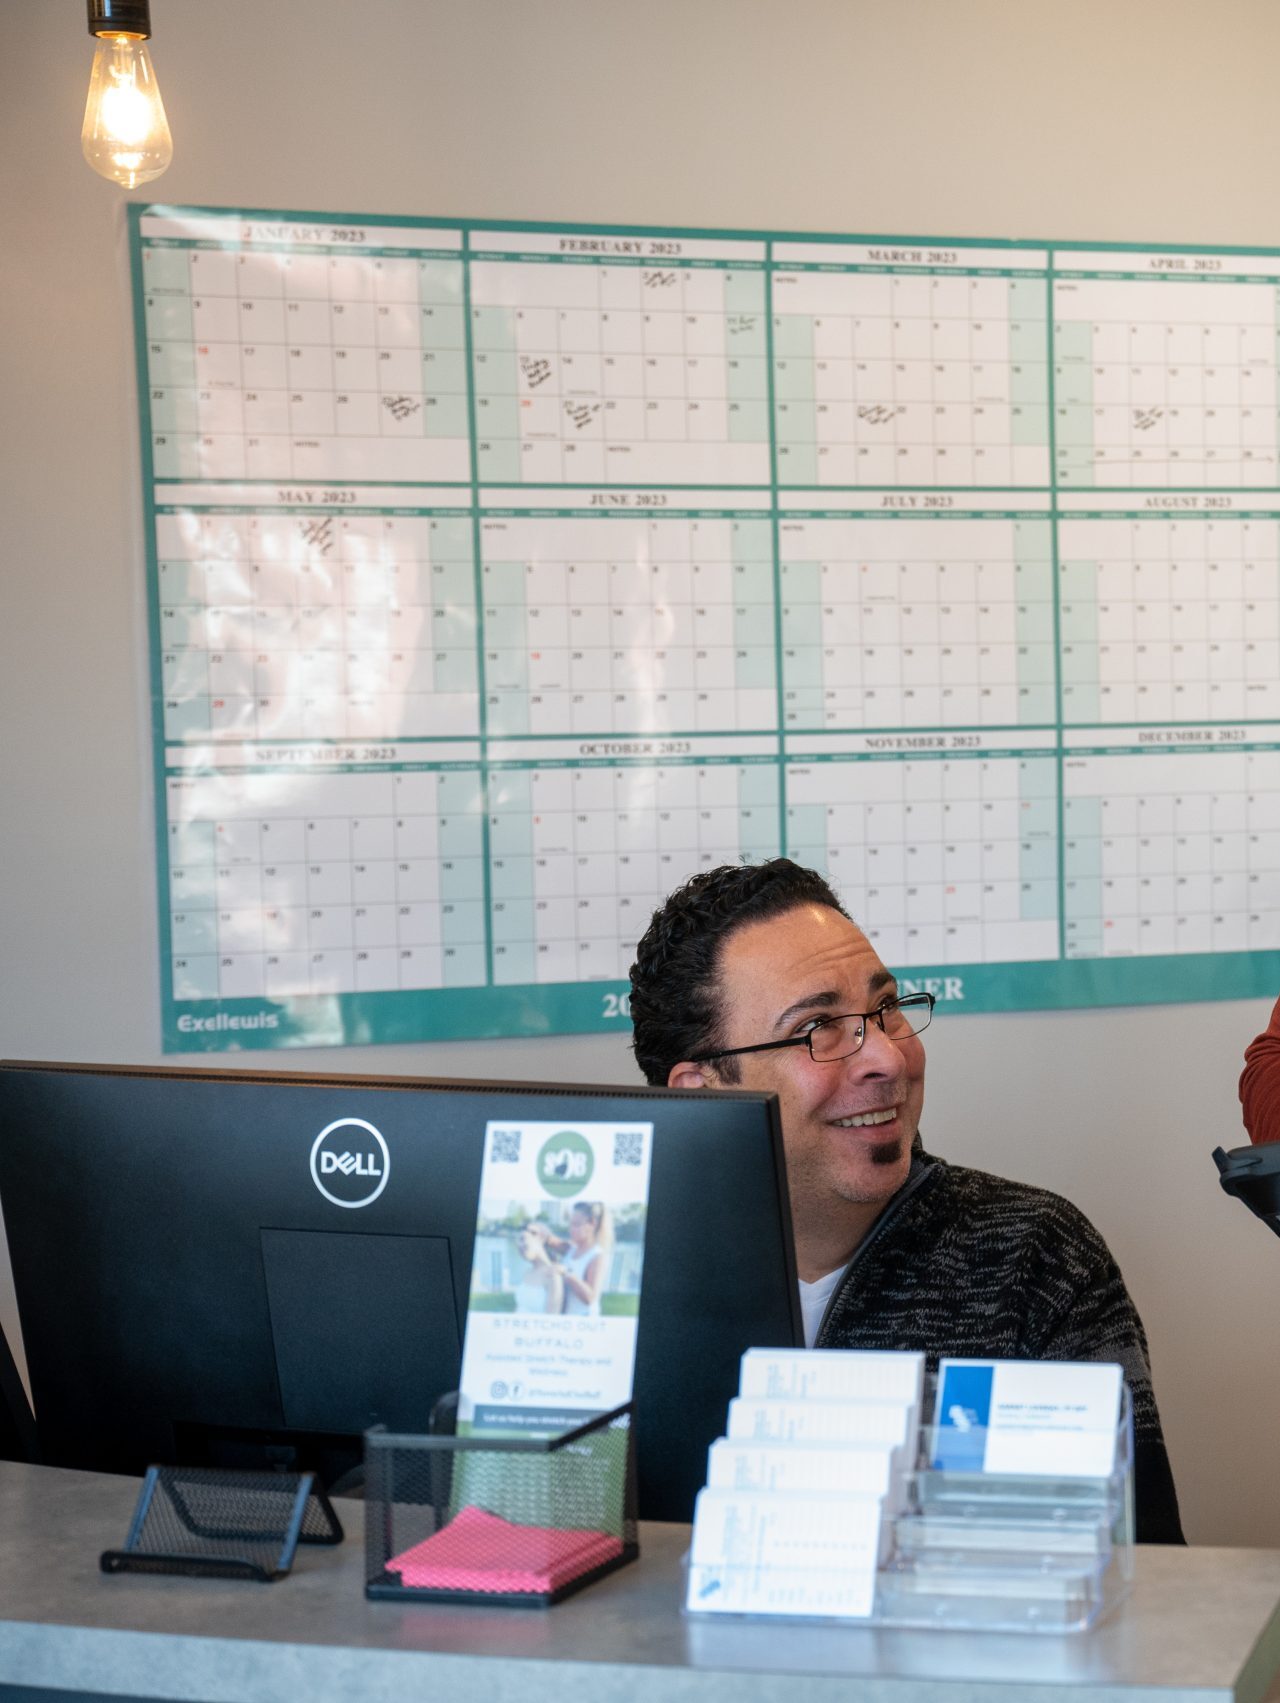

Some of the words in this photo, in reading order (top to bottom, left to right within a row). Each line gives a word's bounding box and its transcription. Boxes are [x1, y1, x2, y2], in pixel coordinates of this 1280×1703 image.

[330, 229, 367, 242] 2023
[559, 239, 644, 253] FEBRUARY
[649, 242, 682, 254] 2023
[867, 250, 922, 262] MARCH
[927, 252, 957, 263] 2023
[1148, 259, 1188, 270] APRIL
[1194, 260, 1222, 271] 2023
[278, 491, 315, 503] MAY
[321, 491, 356, 503] 2023
[589, 494, 630, 506] JUNE
[635, 494, 667, 506] 2023
[881, 496, 917, 507] JULY
[923, 496, 953, 507] 2023
[1144, 497, 1199, 508] AUGUST
[1203, 497, 1232, 508] 2023
[865, 736, 946, 749] NOVEMBER
[952, 735, 981, 748] 2023
[1138, 731, 1213, 743] DECEMBER
[1218, 730, 1247, 741] 2023
[255, 748, 356, 761] SEPTEMBER
[363, 747, 397, 759] 2023
[579, 743, 653, 755] OCTOBER
[659, 742, 691, 754] 2023
[897, 976, 965, 1000] NER
[177, 1010, 279, 1032] Exellewis
[321, 1151, 381, 1176] DELL
